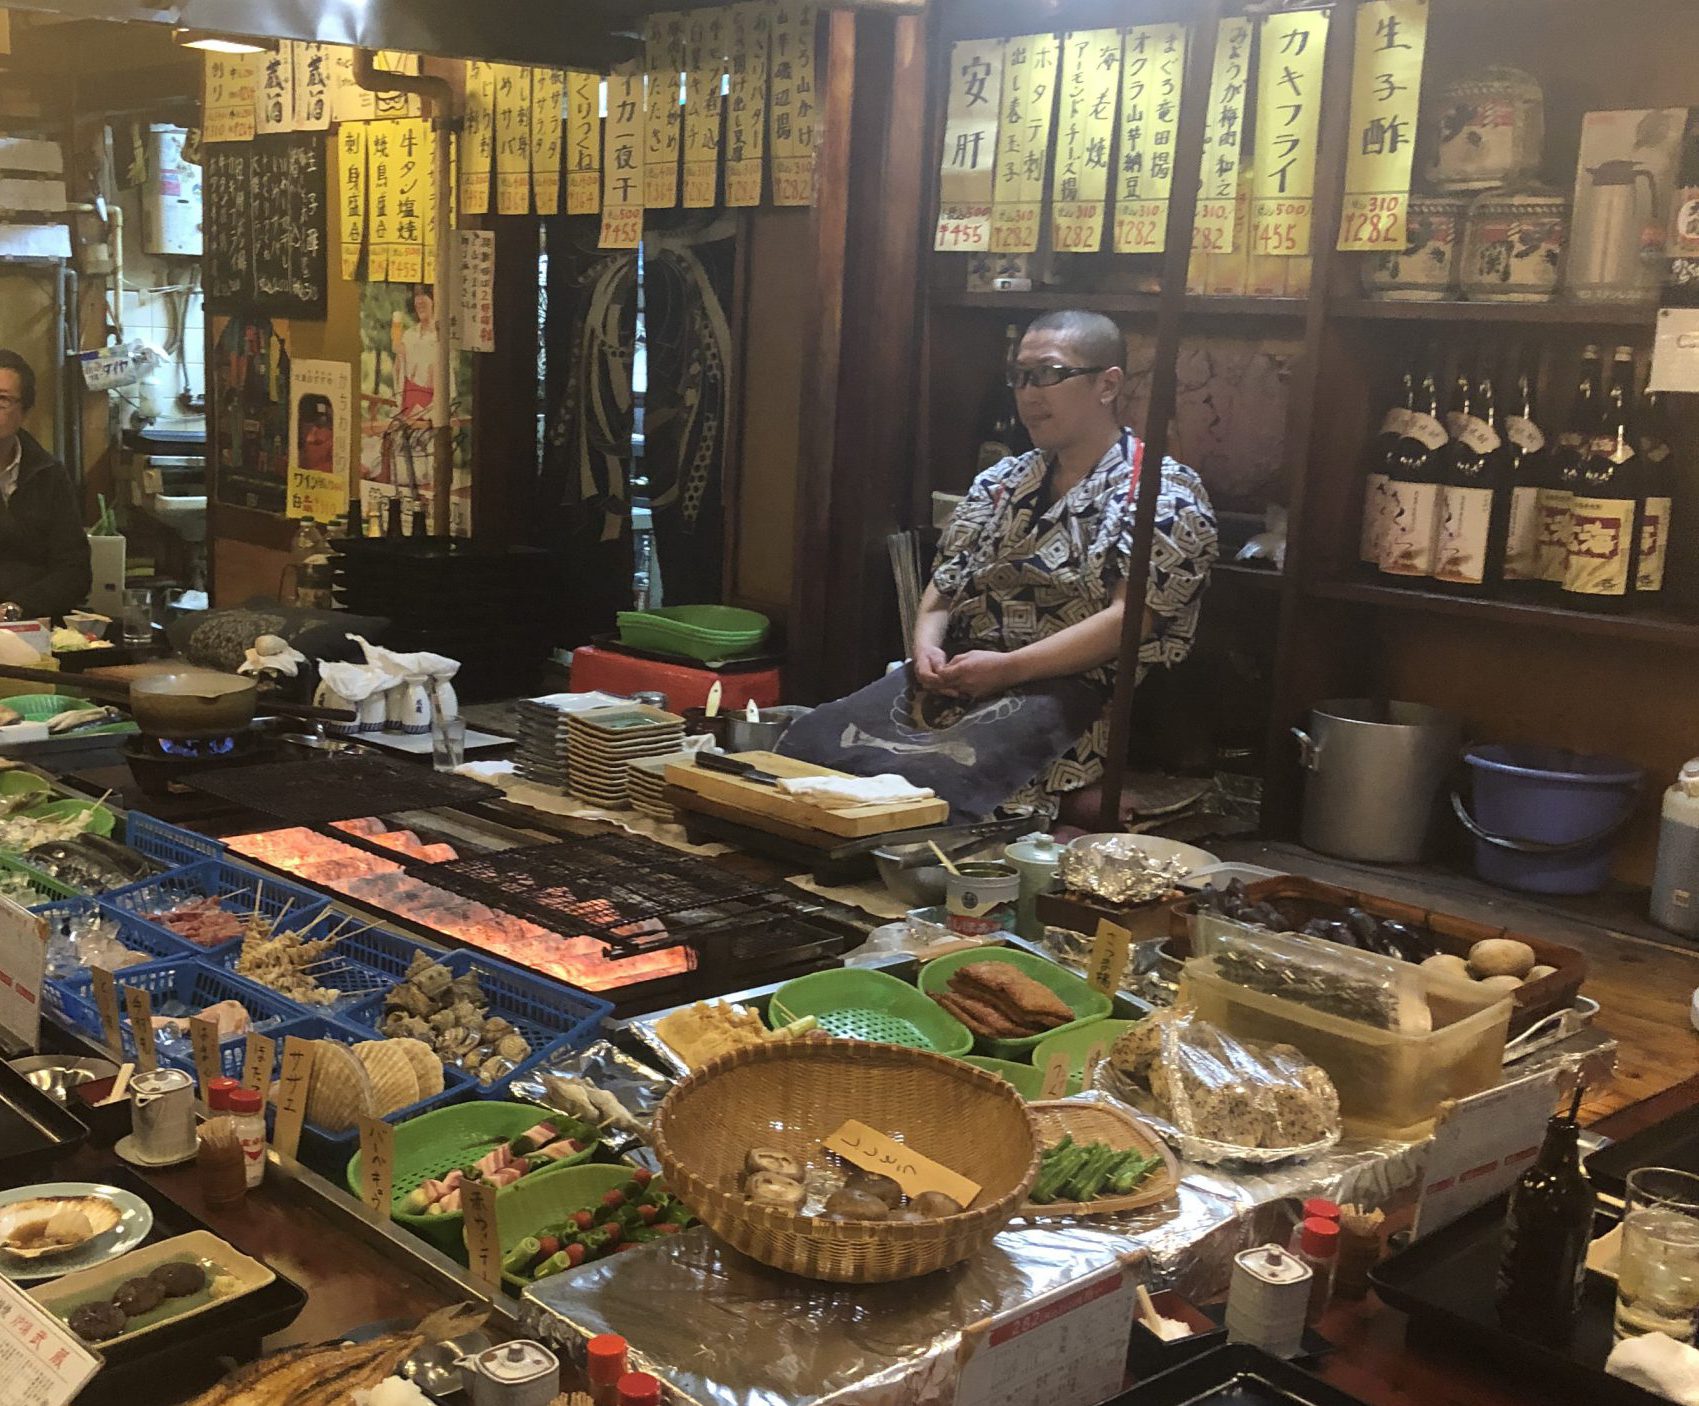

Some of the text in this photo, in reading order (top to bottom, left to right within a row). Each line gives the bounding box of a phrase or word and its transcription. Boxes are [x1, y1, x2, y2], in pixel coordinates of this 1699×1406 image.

[951, 56, 992, 170] 安肝
[1022, 47, 1054, 182] ホタテ刺
[1121, 32, 1151, 201] オクラ山芋納豆
[1150, 33, 1179, 180] まぐろ竜田揚
[1268, 28, 1311, 194] カキフライ
[396, 128, 420, 243] 牛タン塩焼
[938, 223, 983, 247] ¥455
[840, 1137, 918, 1177] ししとう
